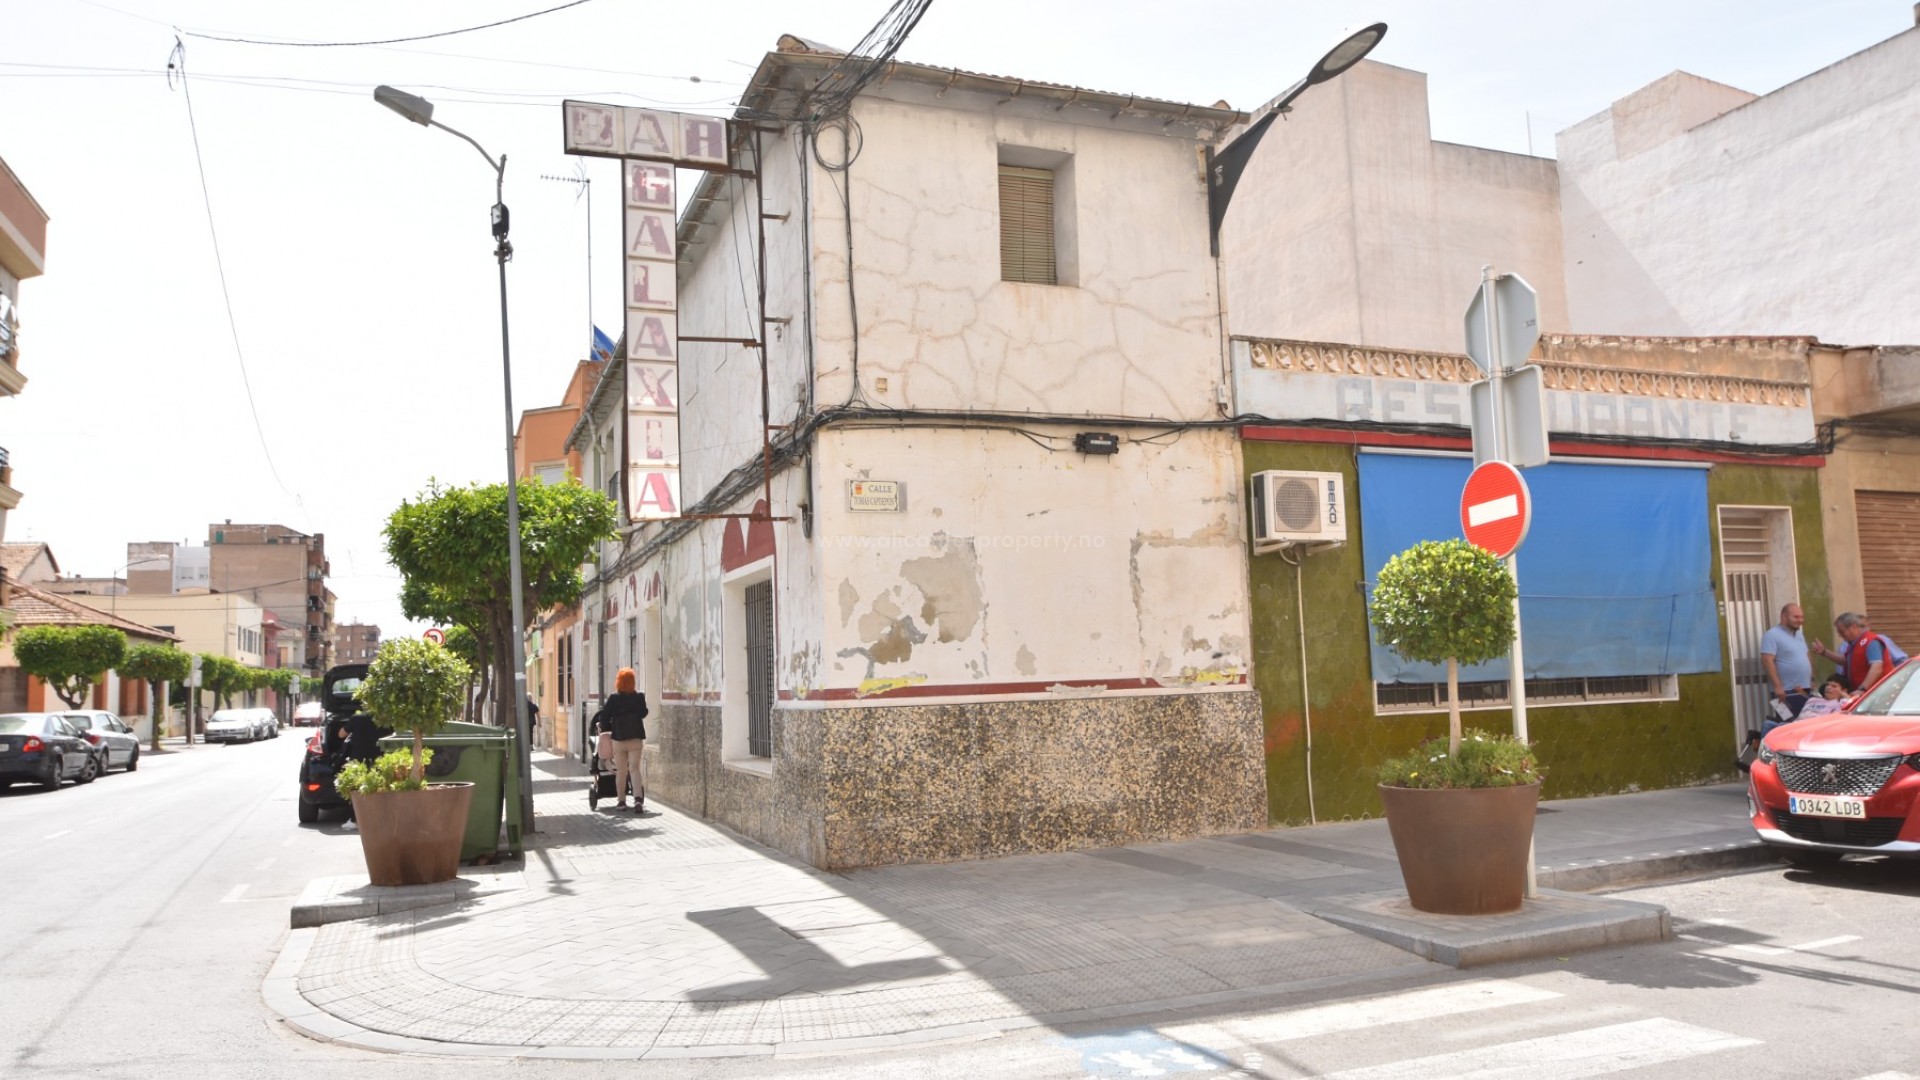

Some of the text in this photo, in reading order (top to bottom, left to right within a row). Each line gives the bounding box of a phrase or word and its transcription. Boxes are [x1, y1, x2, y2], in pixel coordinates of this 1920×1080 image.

[573, 106, 723, 159] BAR
[631, 163, 677, 513] GALAXIA
[868, 485, 892, 493] CALLE
[1327, 480, 1337, 524] BEKO
[1798, 799, 1861, 816] 0342 LDB
